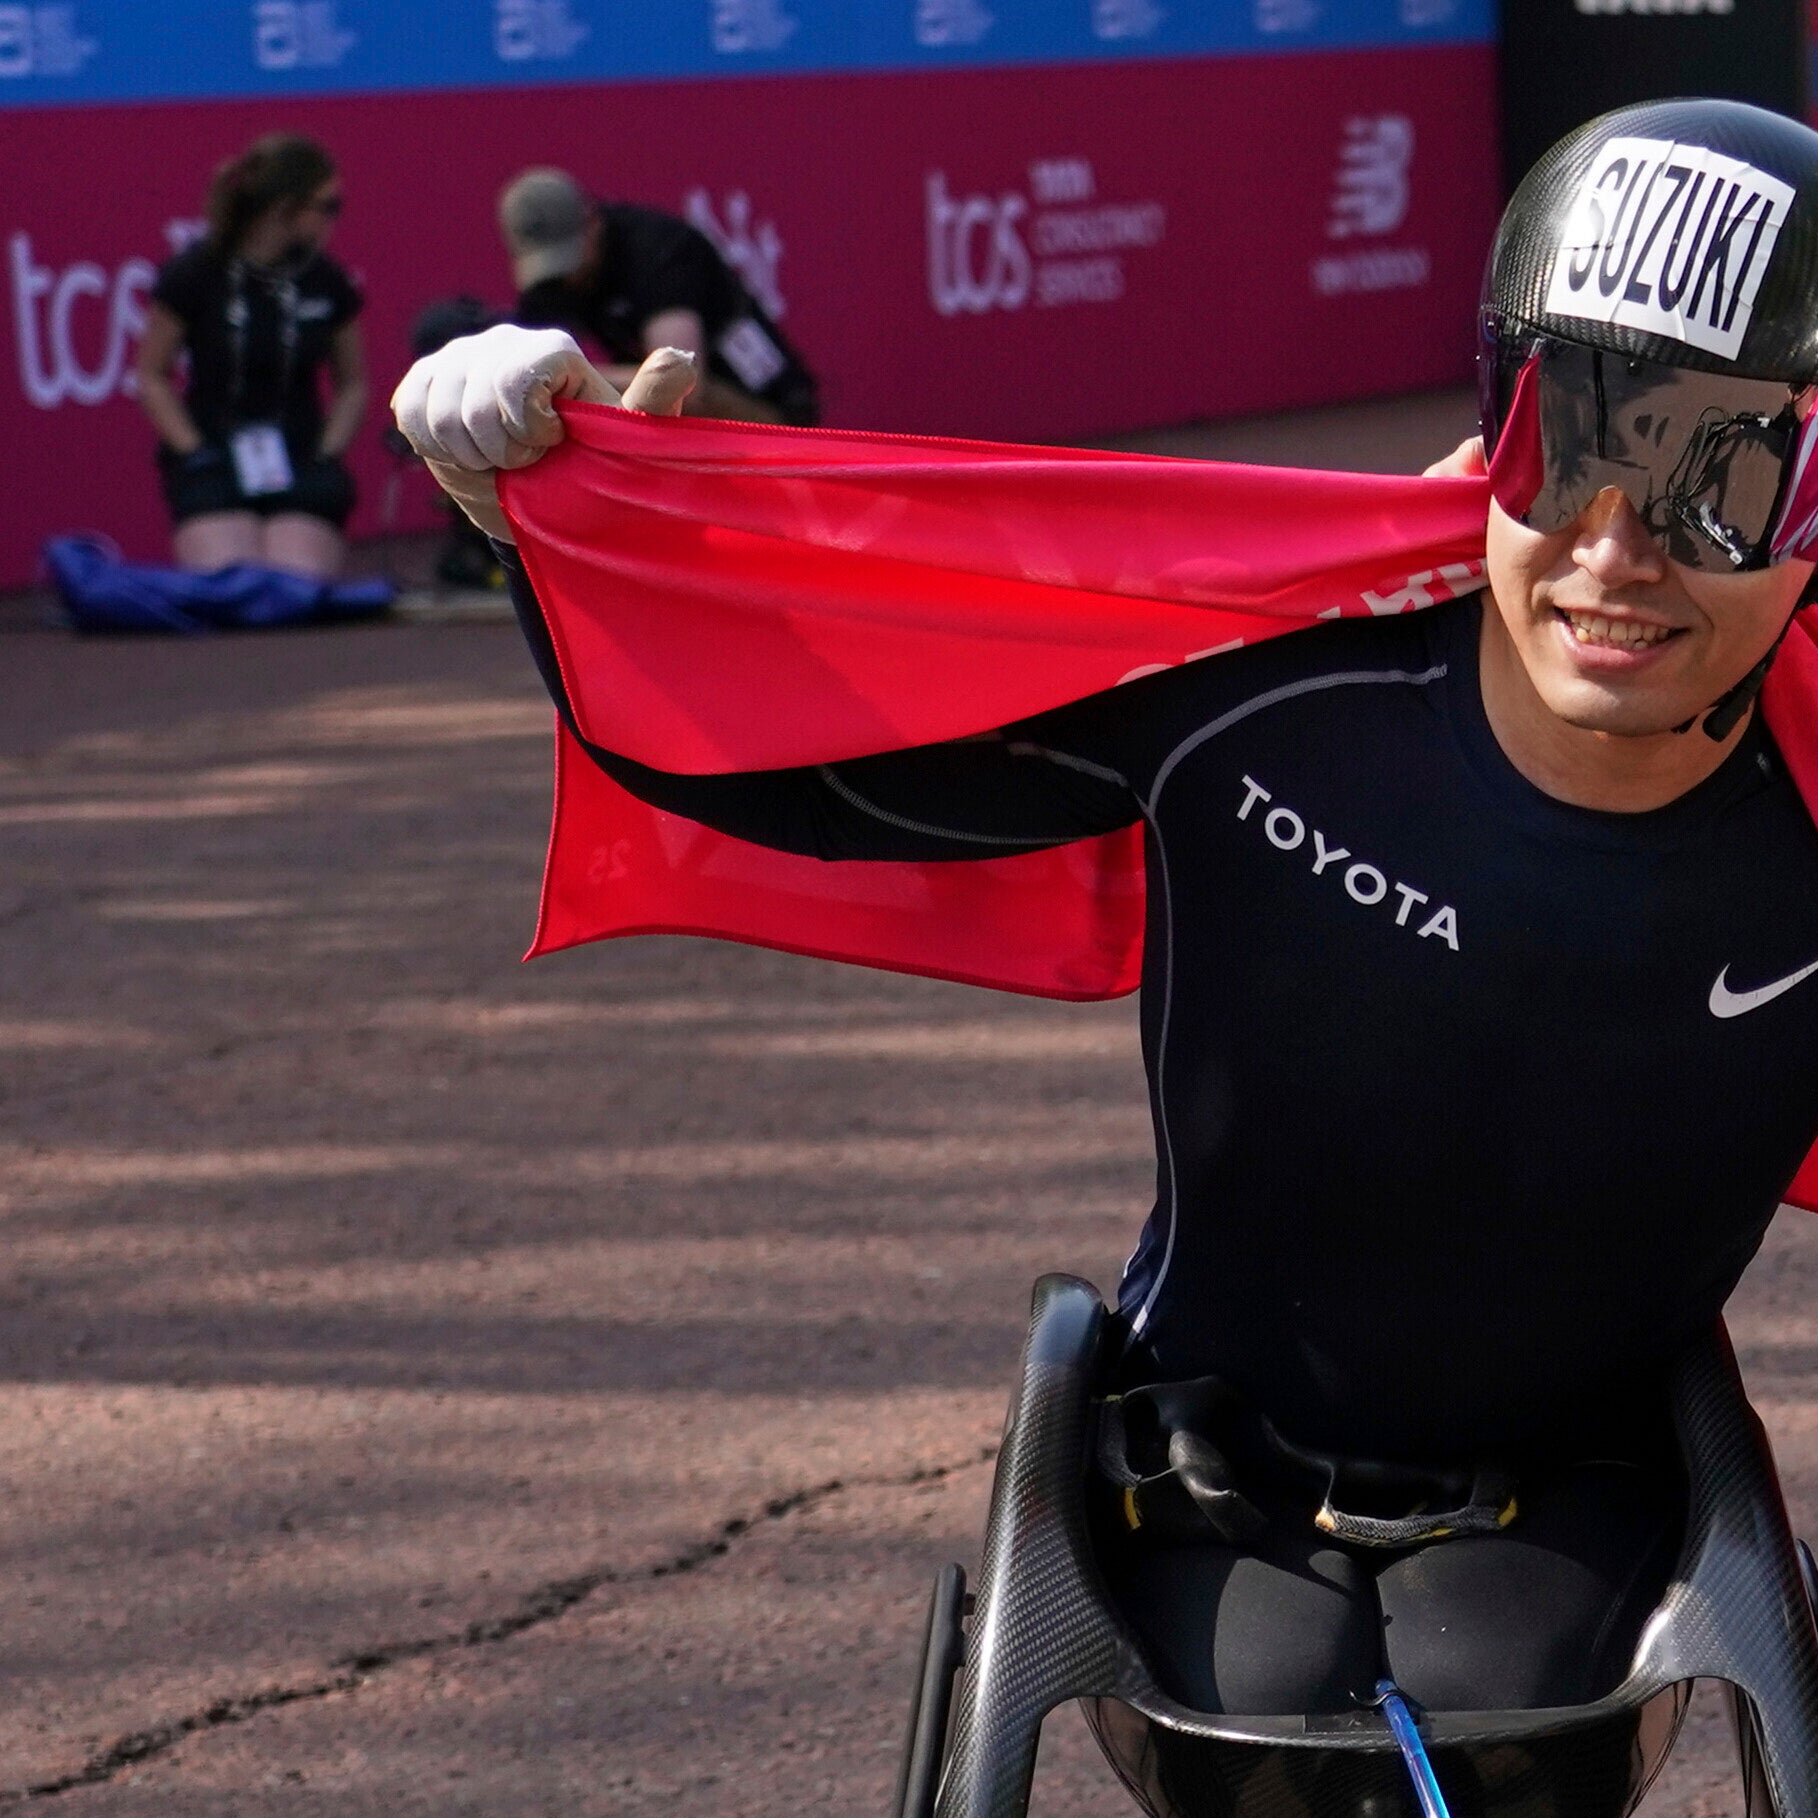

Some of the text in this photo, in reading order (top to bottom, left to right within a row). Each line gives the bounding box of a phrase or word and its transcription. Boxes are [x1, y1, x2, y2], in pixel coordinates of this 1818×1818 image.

[926, 170, 1031, 316] tcs
[1567, 156, 1776, 333] SUZUKI
[1233, 774, 1461, 953] TOYOTA
